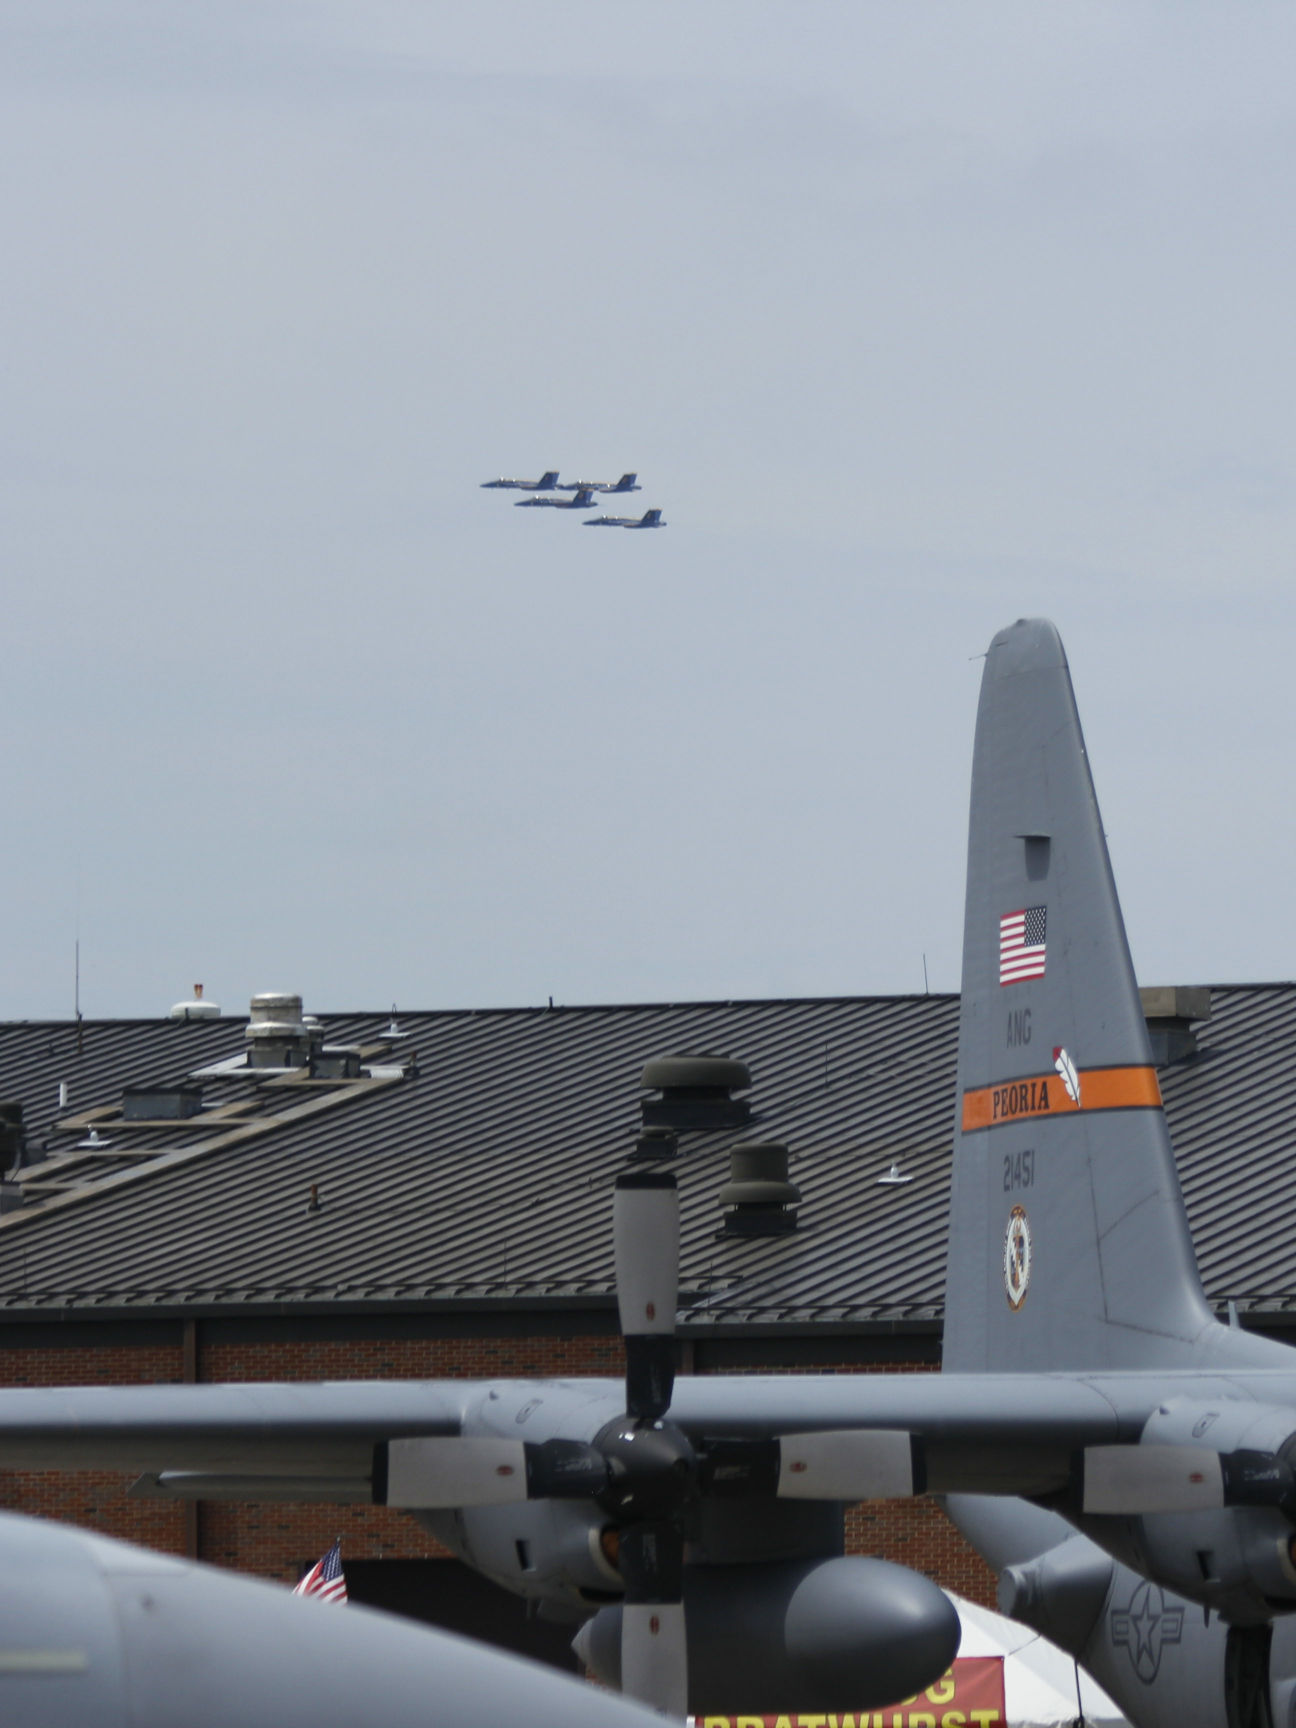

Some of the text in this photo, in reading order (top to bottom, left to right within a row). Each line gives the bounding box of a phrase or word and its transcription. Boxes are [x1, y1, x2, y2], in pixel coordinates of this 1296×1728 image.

[1006, 1008, 1032, 1048] ANG
[993, 1081, 1050, 1120] PEORIA
[1003, 1149, 1035, 1192] 21451
